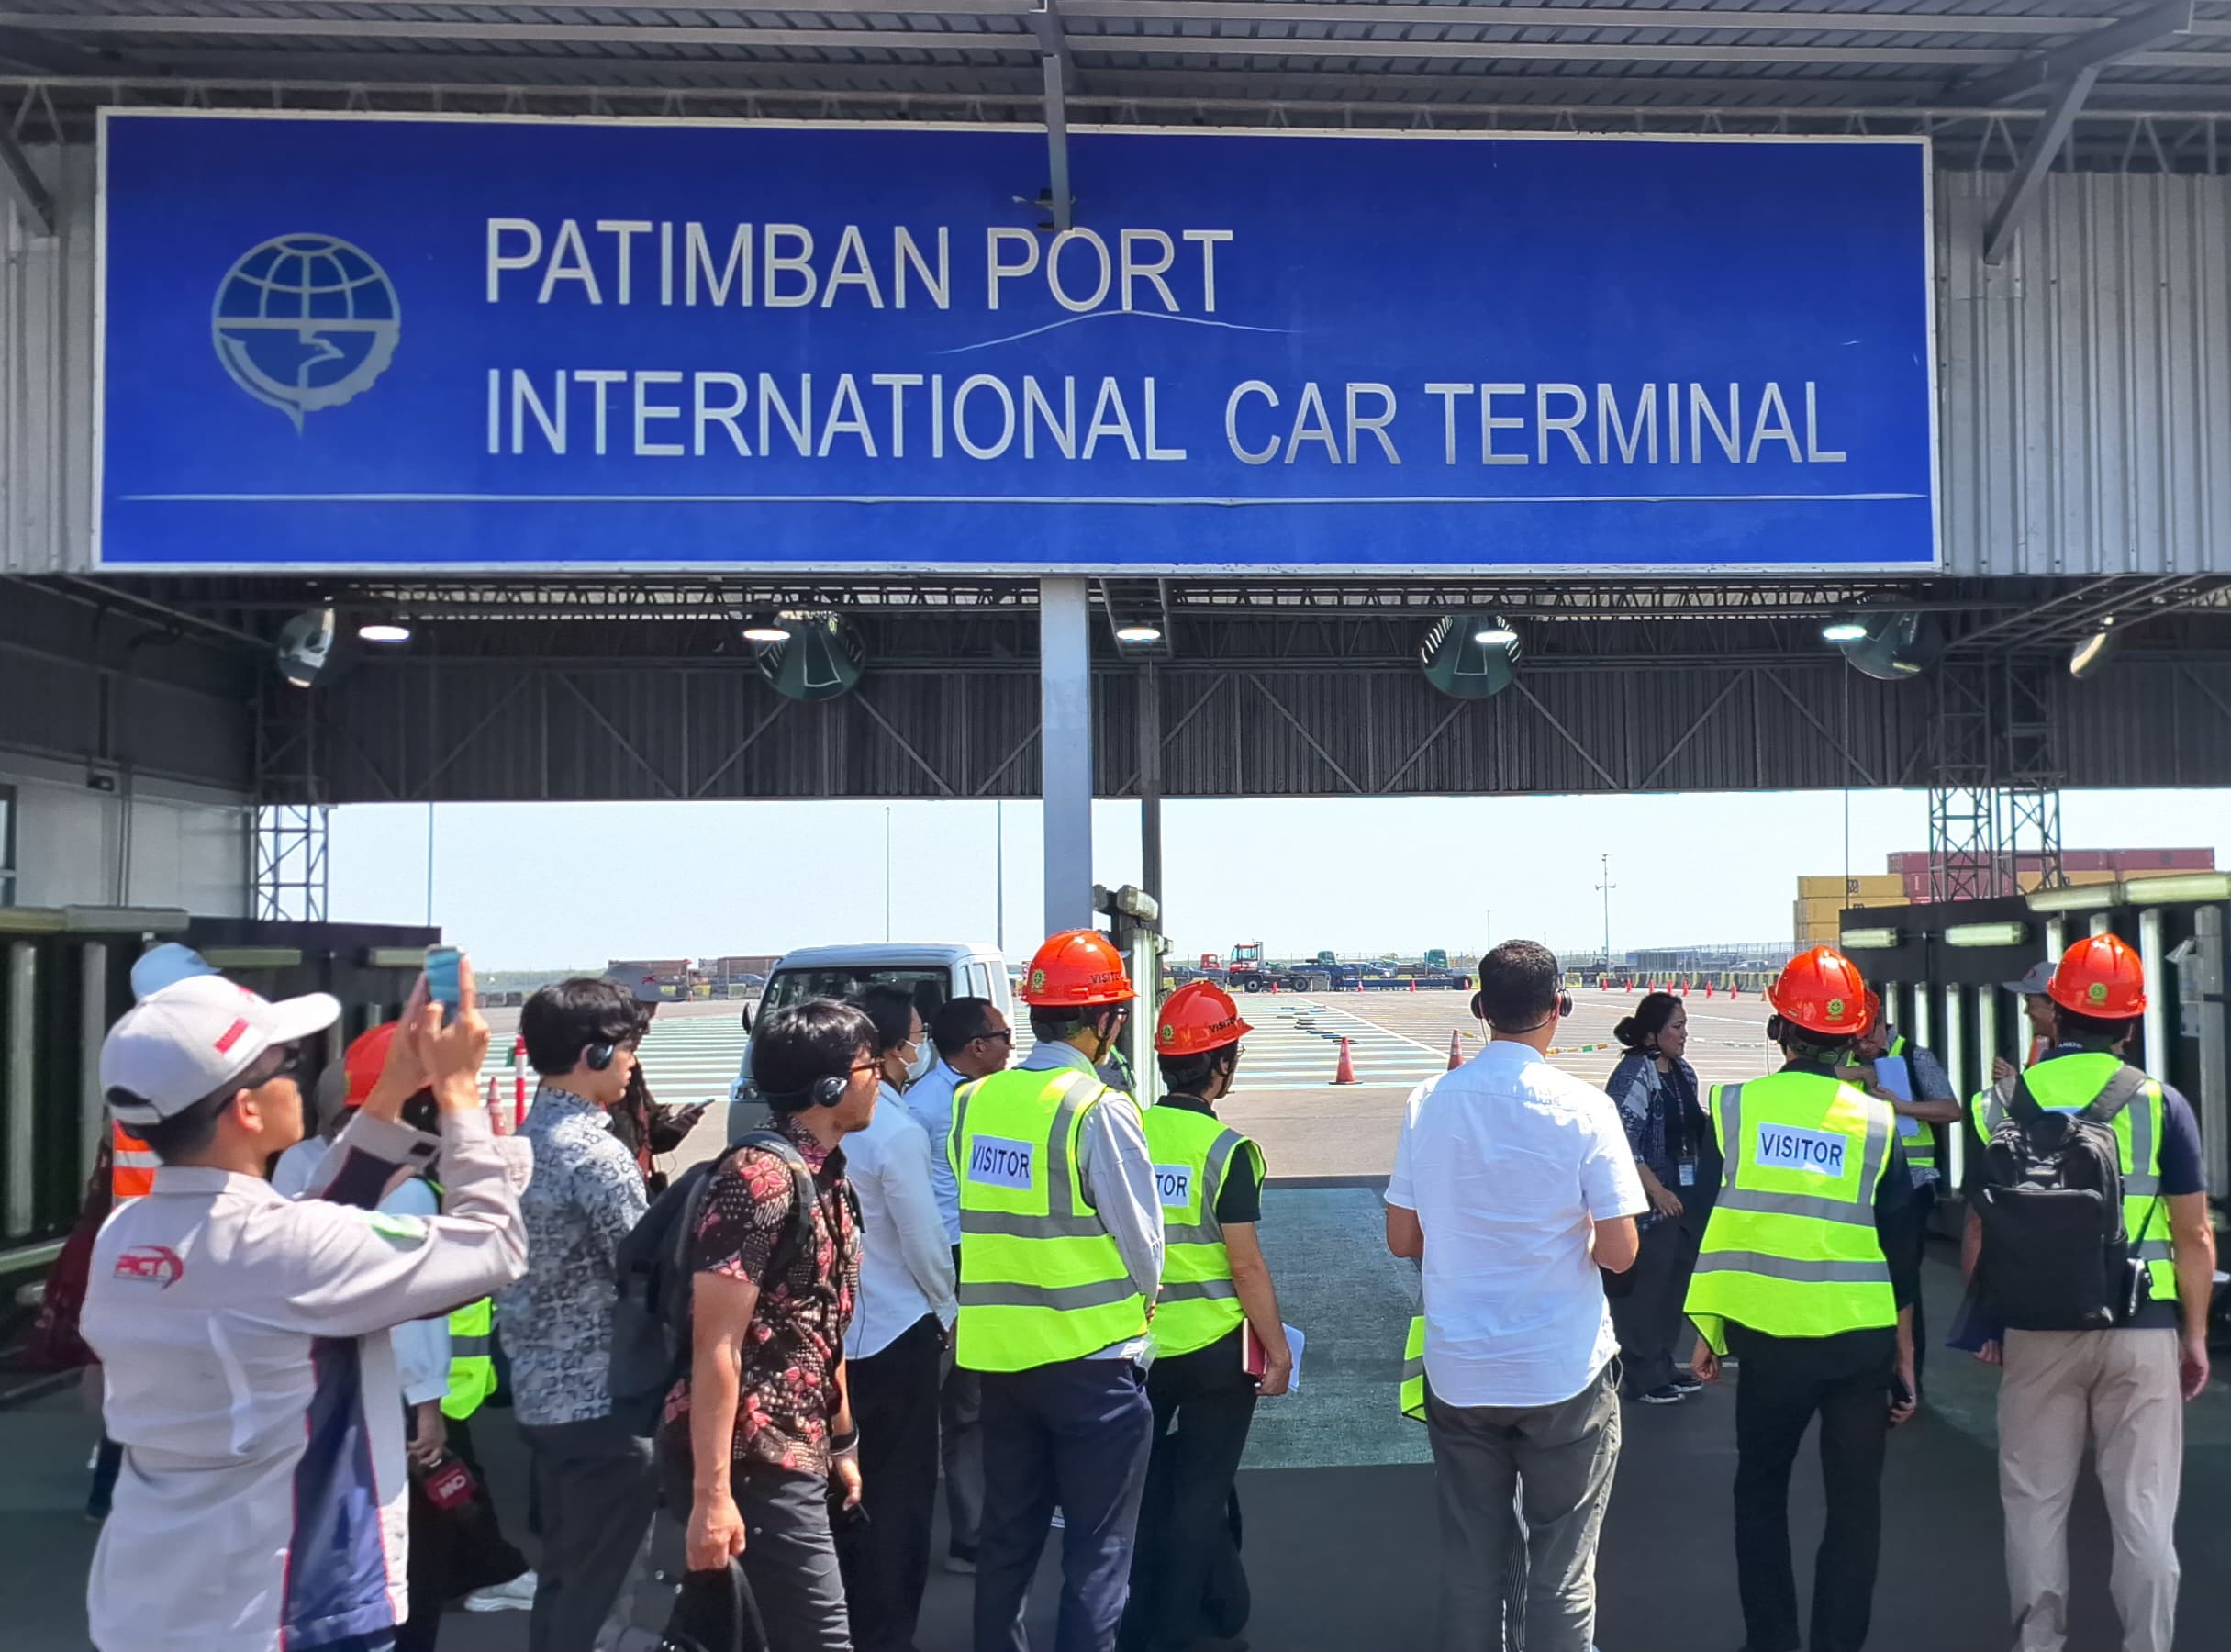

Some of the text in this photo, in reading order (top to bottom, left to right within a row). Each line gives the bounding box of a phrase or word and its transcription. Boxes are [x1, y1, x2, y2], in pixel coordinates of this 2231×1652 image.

[487, 218, 1233, 313] PATIMBAN PORT
[488, 369, 1846, 465] INTERNATIONAL CAR TERMINAL
[972, 1144, 1030, 1178] VISITOR
[1761, 1133, 1843, 1166] VISITOR
